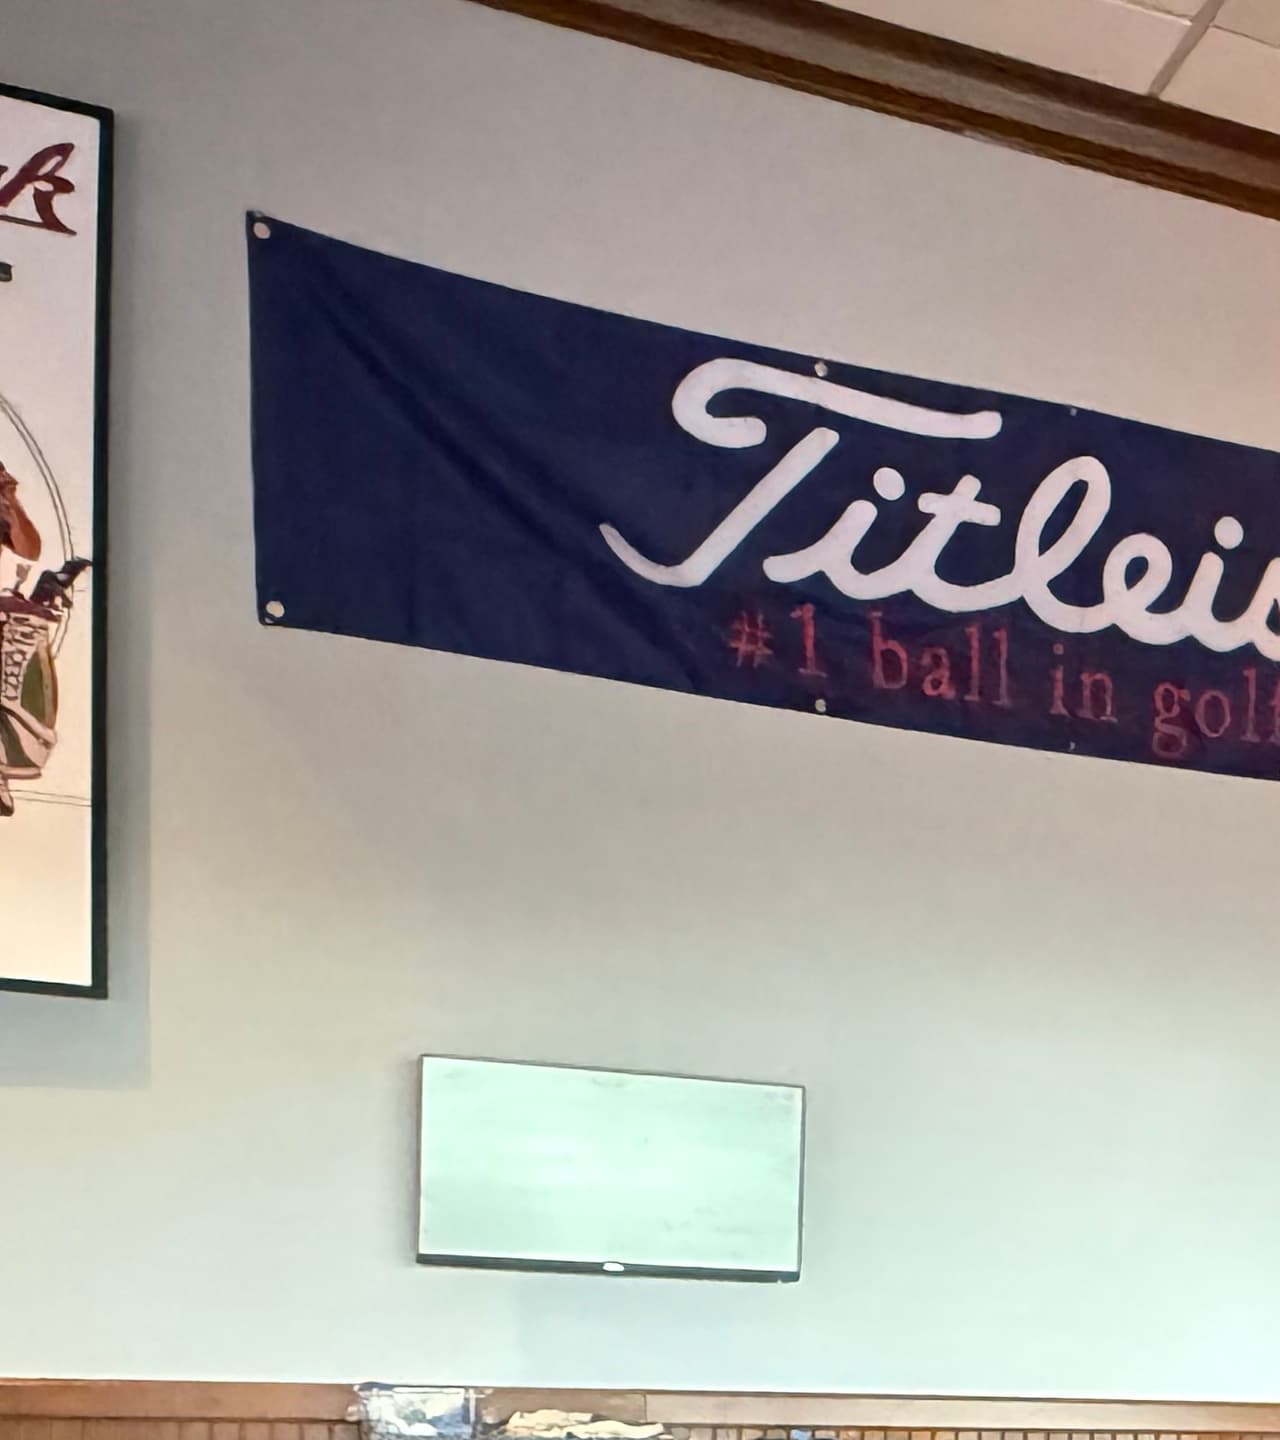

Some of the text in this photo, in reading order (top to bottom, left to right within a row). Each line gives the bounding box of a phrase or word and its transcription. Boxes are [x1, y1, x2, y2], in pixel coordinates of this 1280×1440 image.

[728, 602, 828, 678] #1
[867, 608, 1011, 707] ball
[1049, 643, 1118, 723] in
